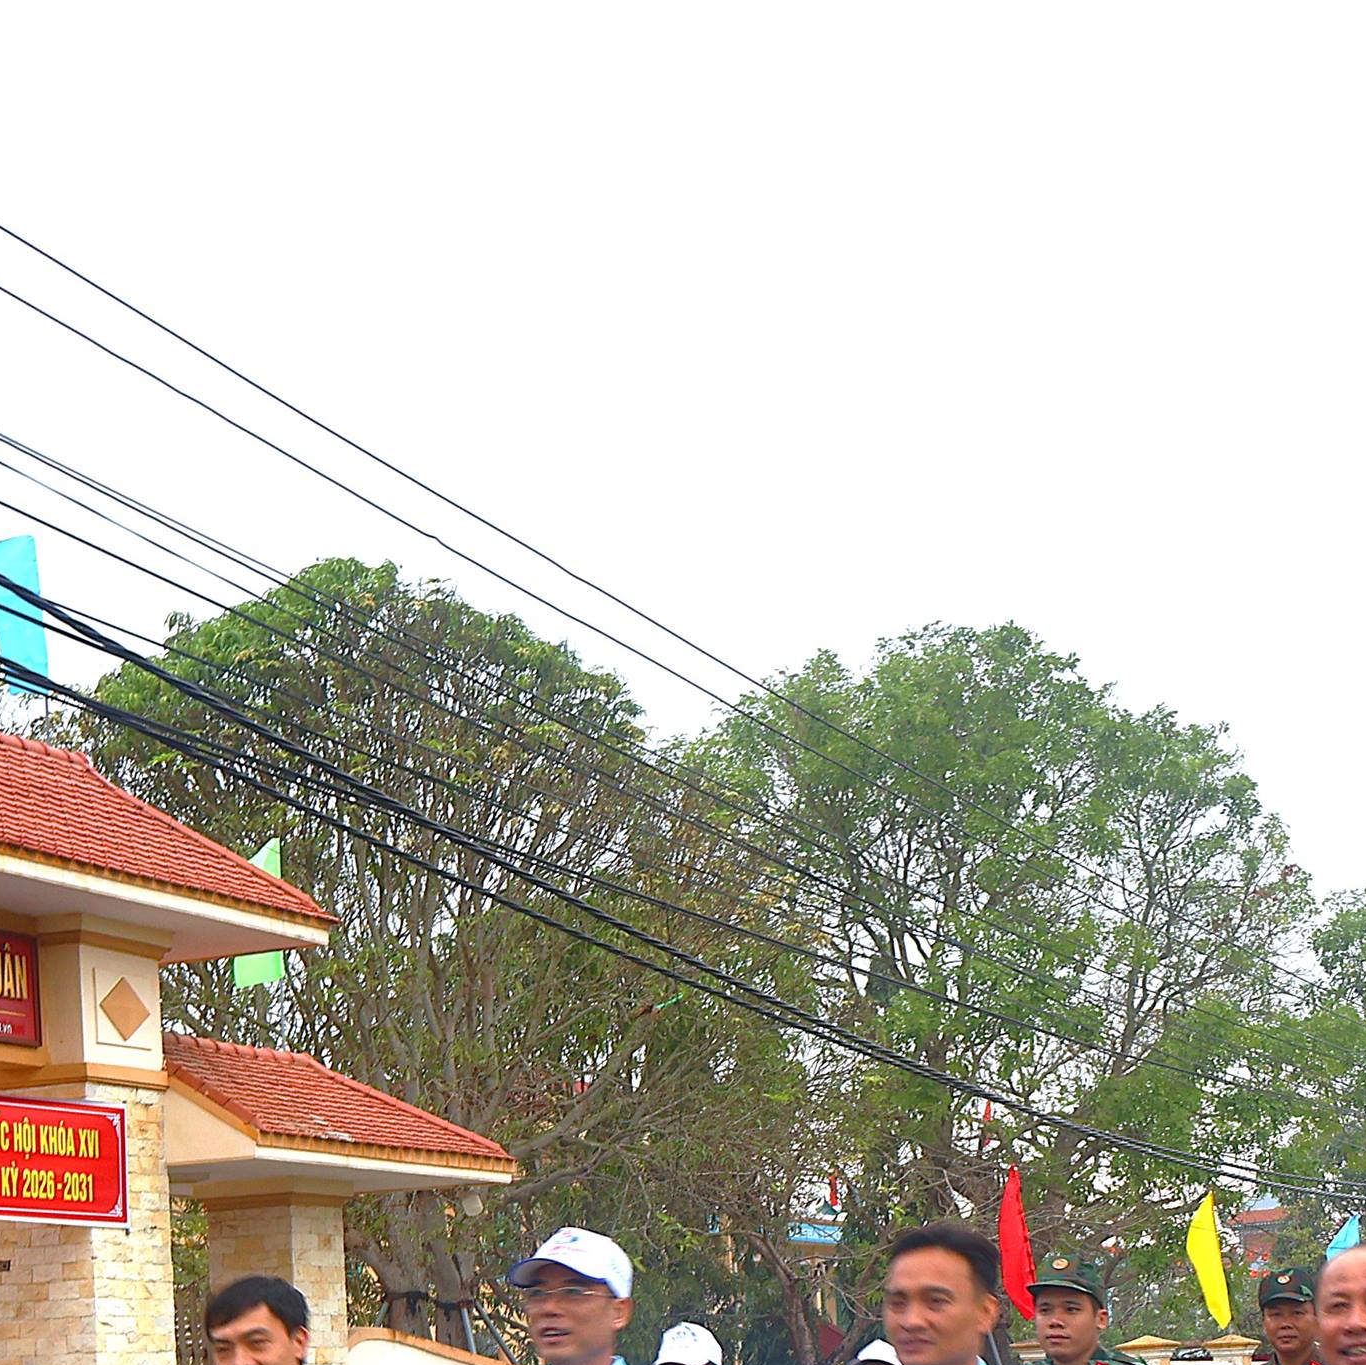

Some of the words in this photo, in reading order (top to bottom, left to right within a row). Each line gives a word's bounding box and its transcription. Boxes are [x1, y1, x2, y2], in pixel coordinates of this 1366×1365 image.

[13, 1117, 36, 1160] HỘI
[40, 1120, 76, 1158] KHÓA
[78, 1128, 100, 1159] XVI
[1, 1161, 19, 1198] KỲ
